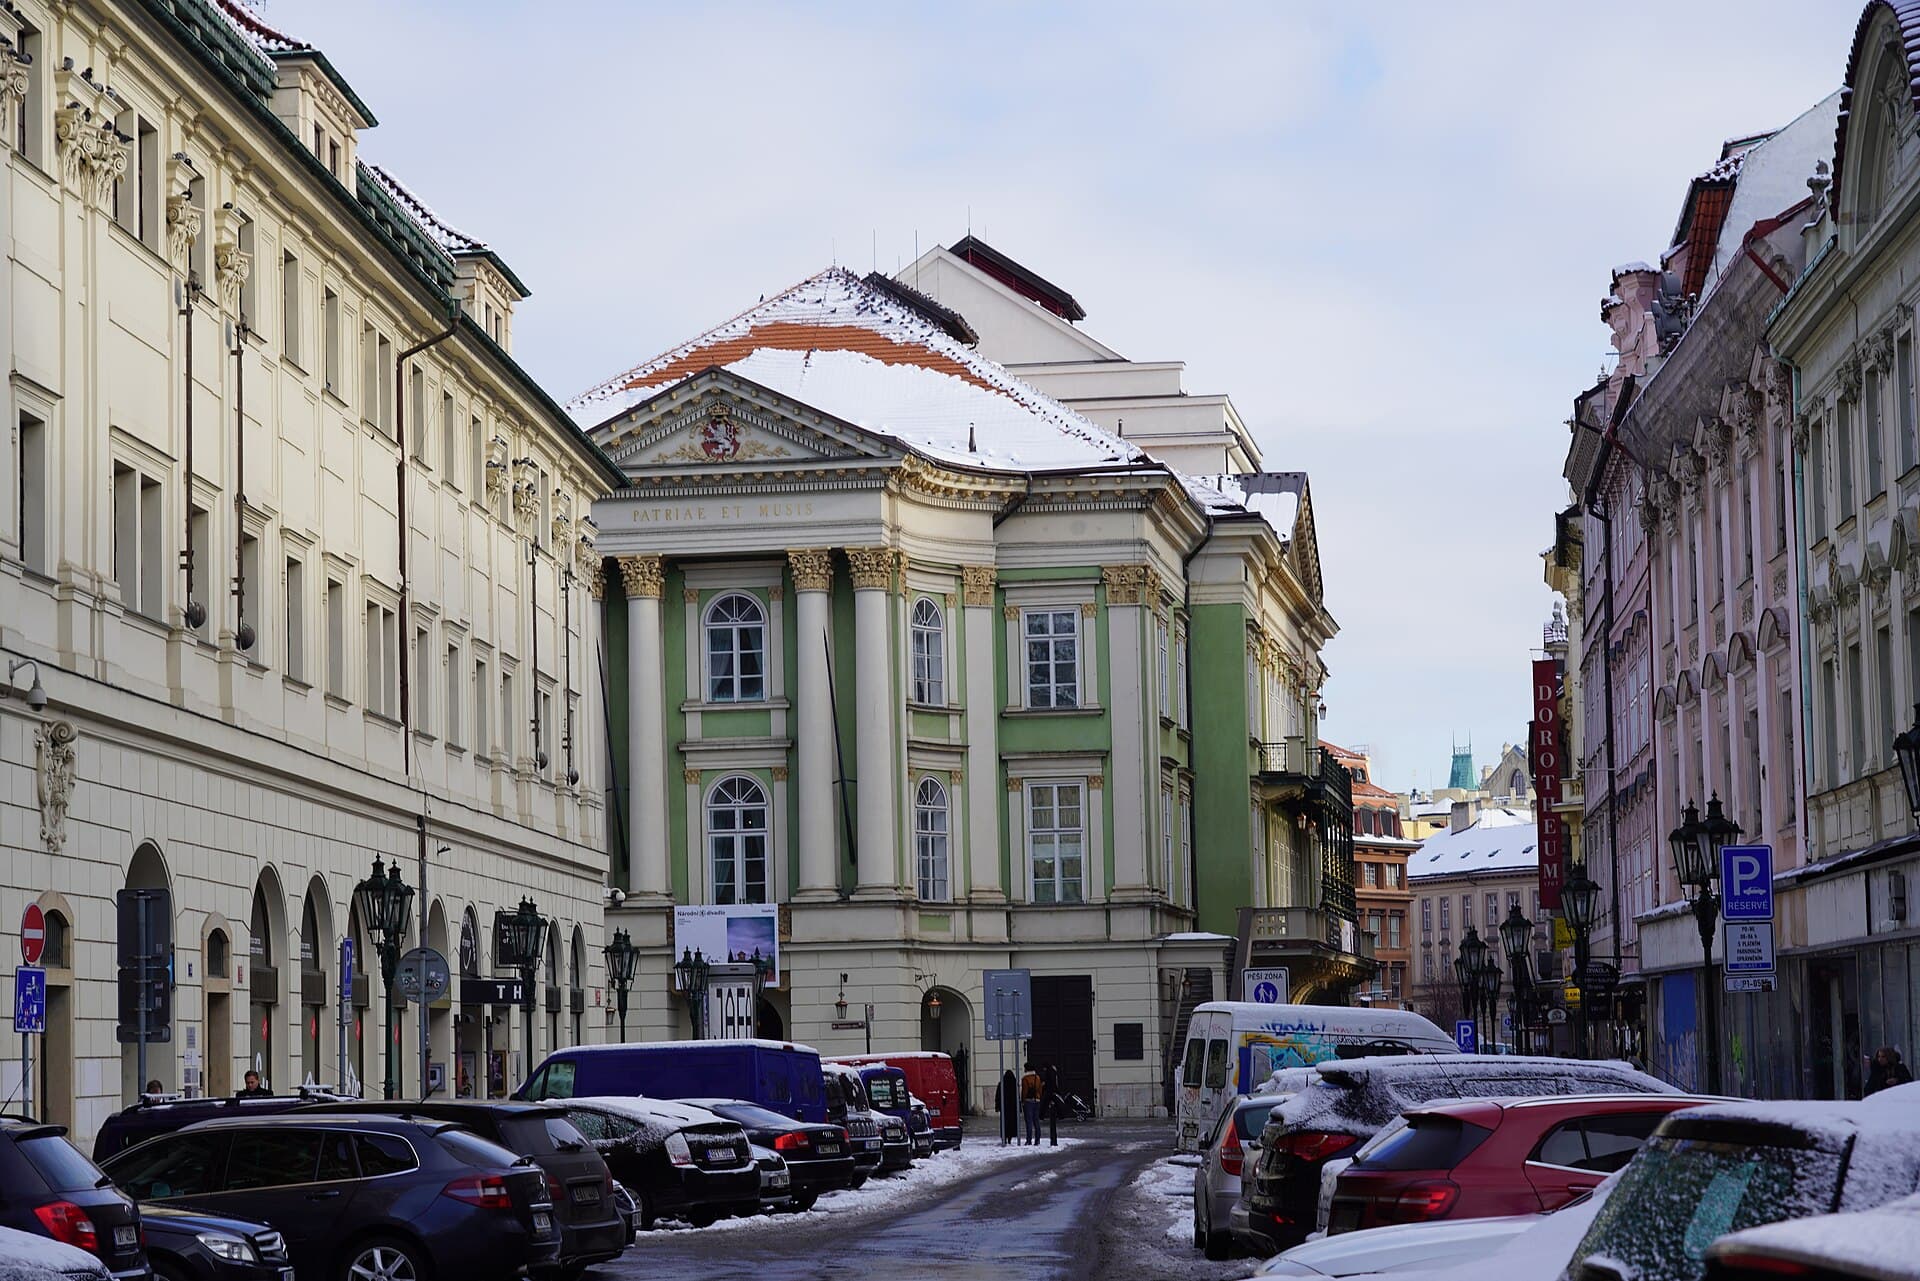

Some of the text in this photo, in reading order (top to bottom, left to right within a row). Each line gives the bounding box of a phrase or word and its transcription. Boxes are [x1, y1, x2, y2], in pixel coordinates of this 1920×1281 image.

[633, 503, 814, 522] PATRIAE ET MUSIS
[1538, 684, 1559, 880] DOROTHEUM
[1732, 855, 1761, 897] P
[1461, 1025, 1473, 1042] P
